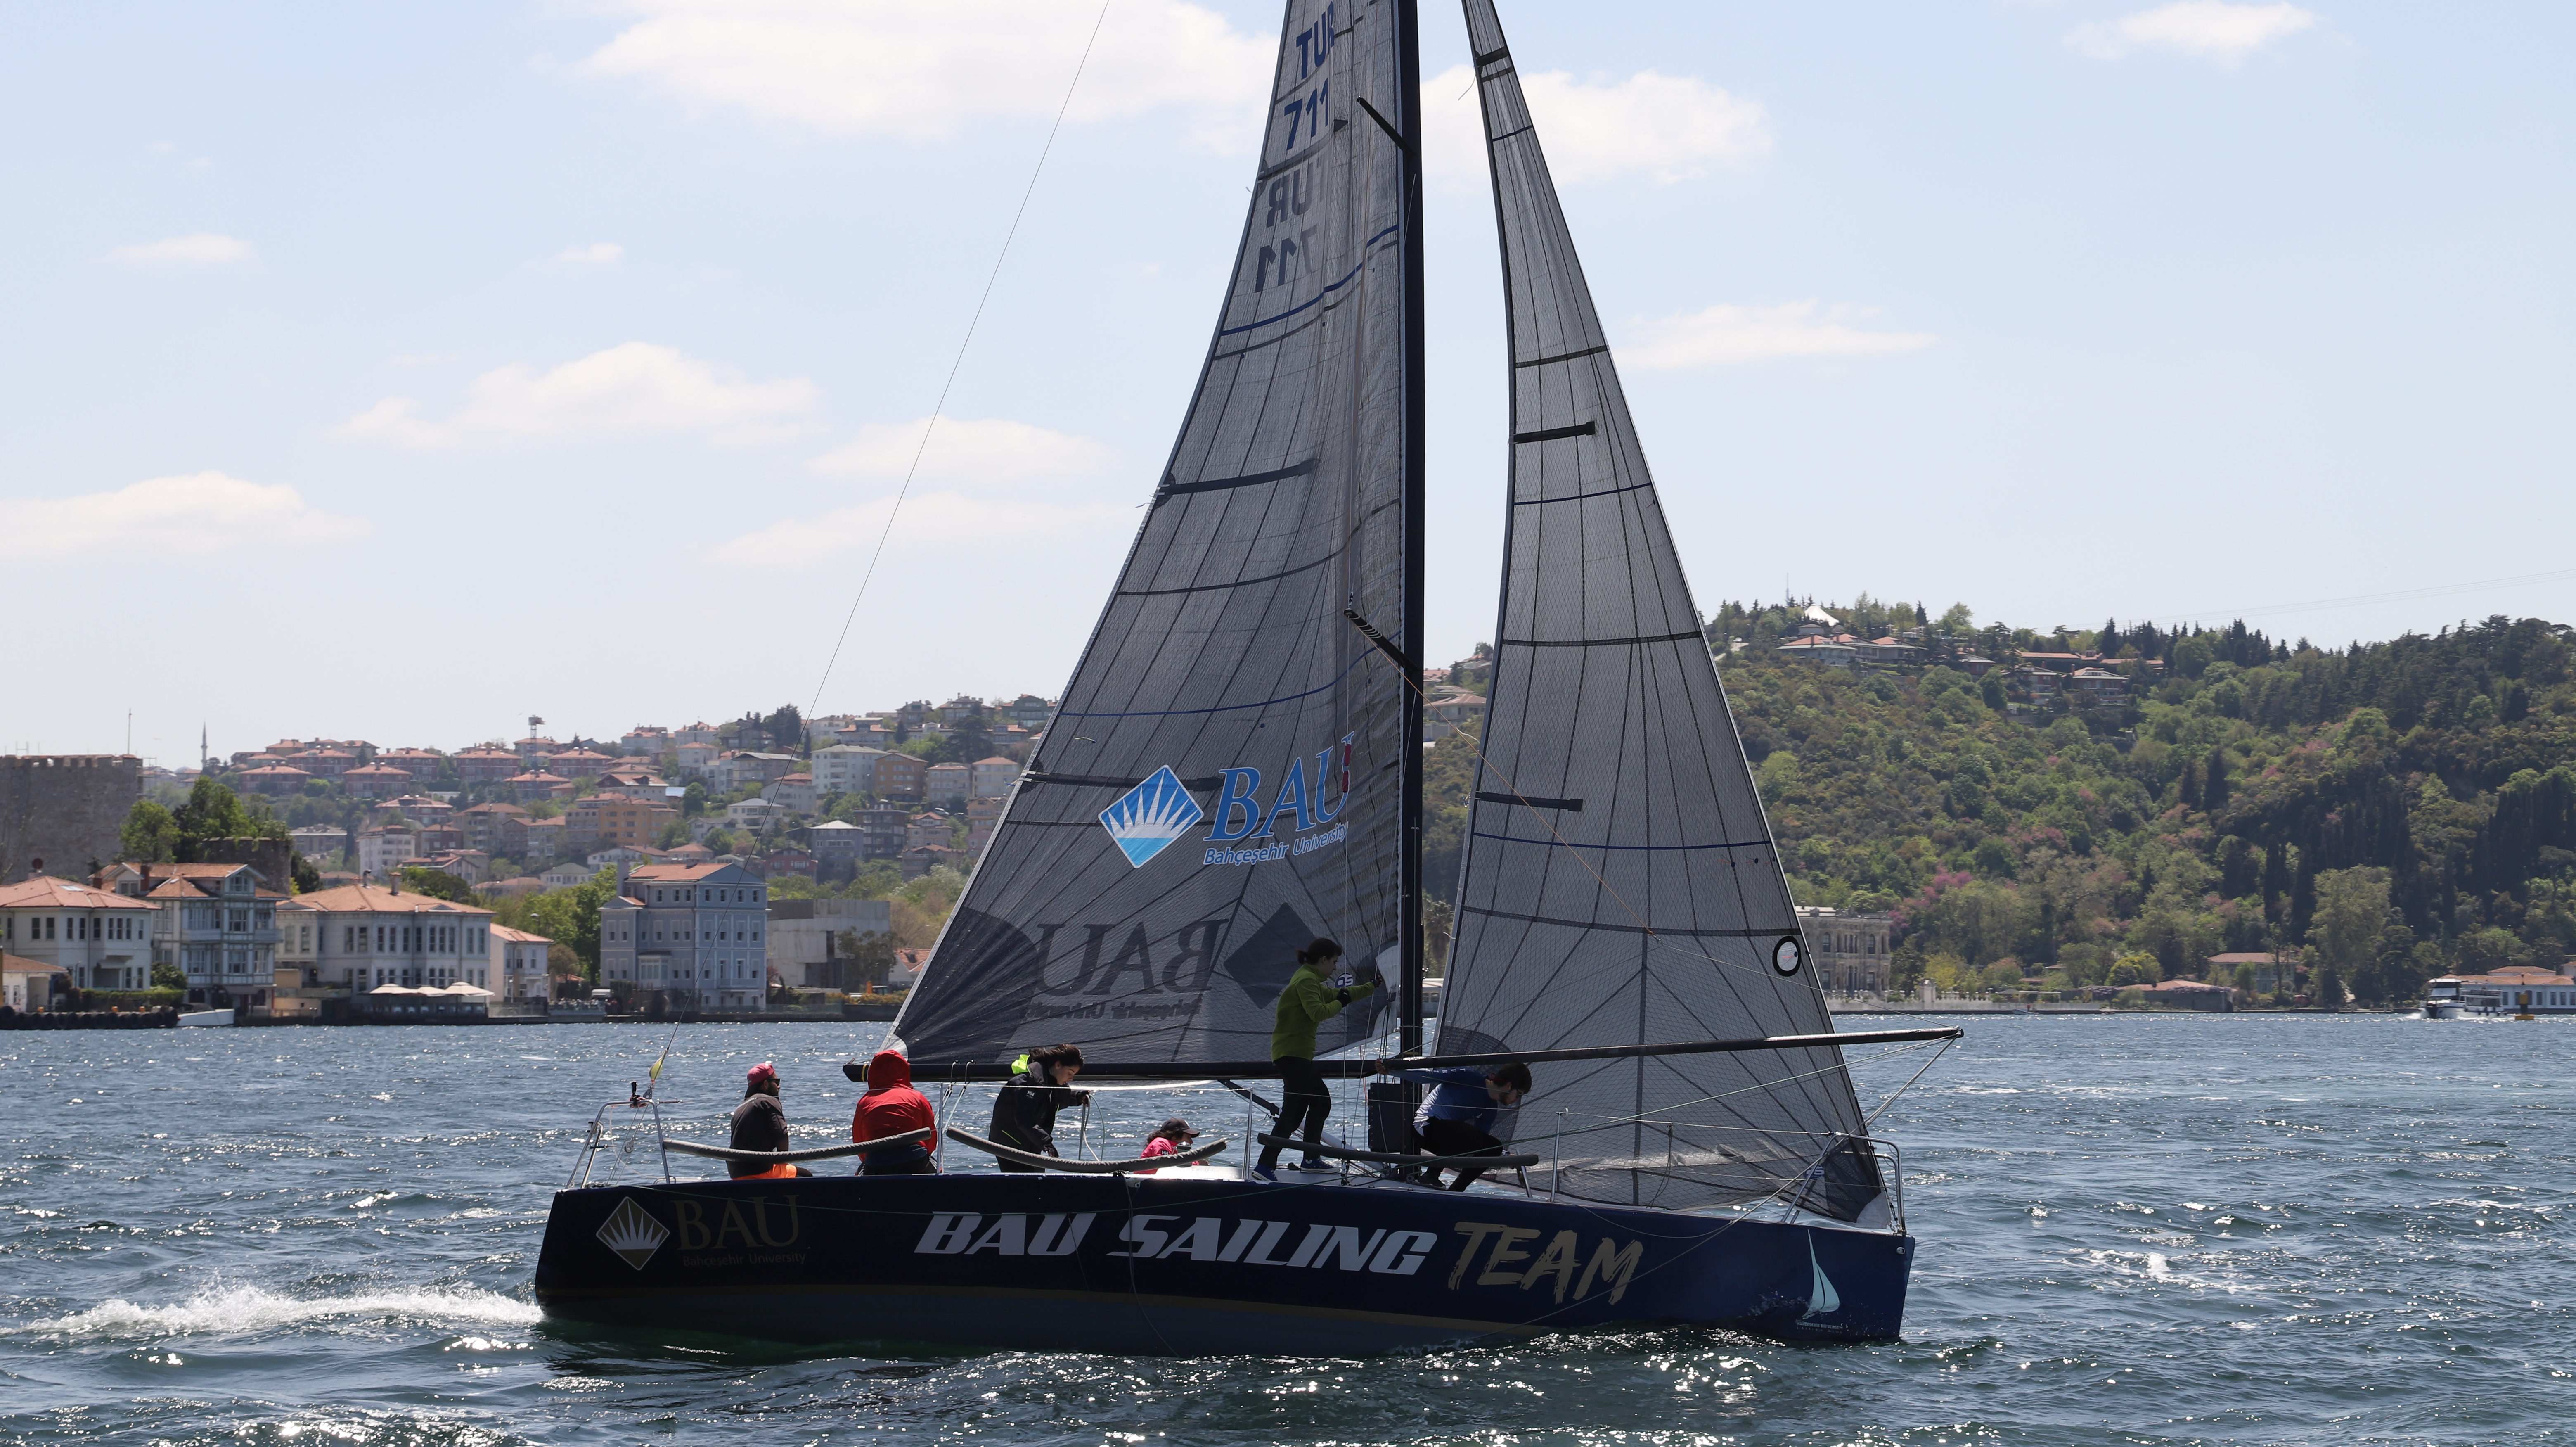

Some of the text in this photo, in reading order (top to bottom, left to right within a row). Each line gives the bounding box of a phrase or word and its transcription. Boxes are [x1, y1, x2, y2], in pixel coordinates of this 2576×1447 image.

[1296, 1, 1334, 80] TUR
[1284, 78, 1328, 150] 711
[1203, 731, 1354, 842] BAU
[1203, 822, 1349, 866] Bahçeşehir University
[670, 1194, 800, 1250] BAU
[914, 1211, 1644, 1305] BAU SAILING TEAM
[682, 1251, 806, 1267] Bahçeşehir University
